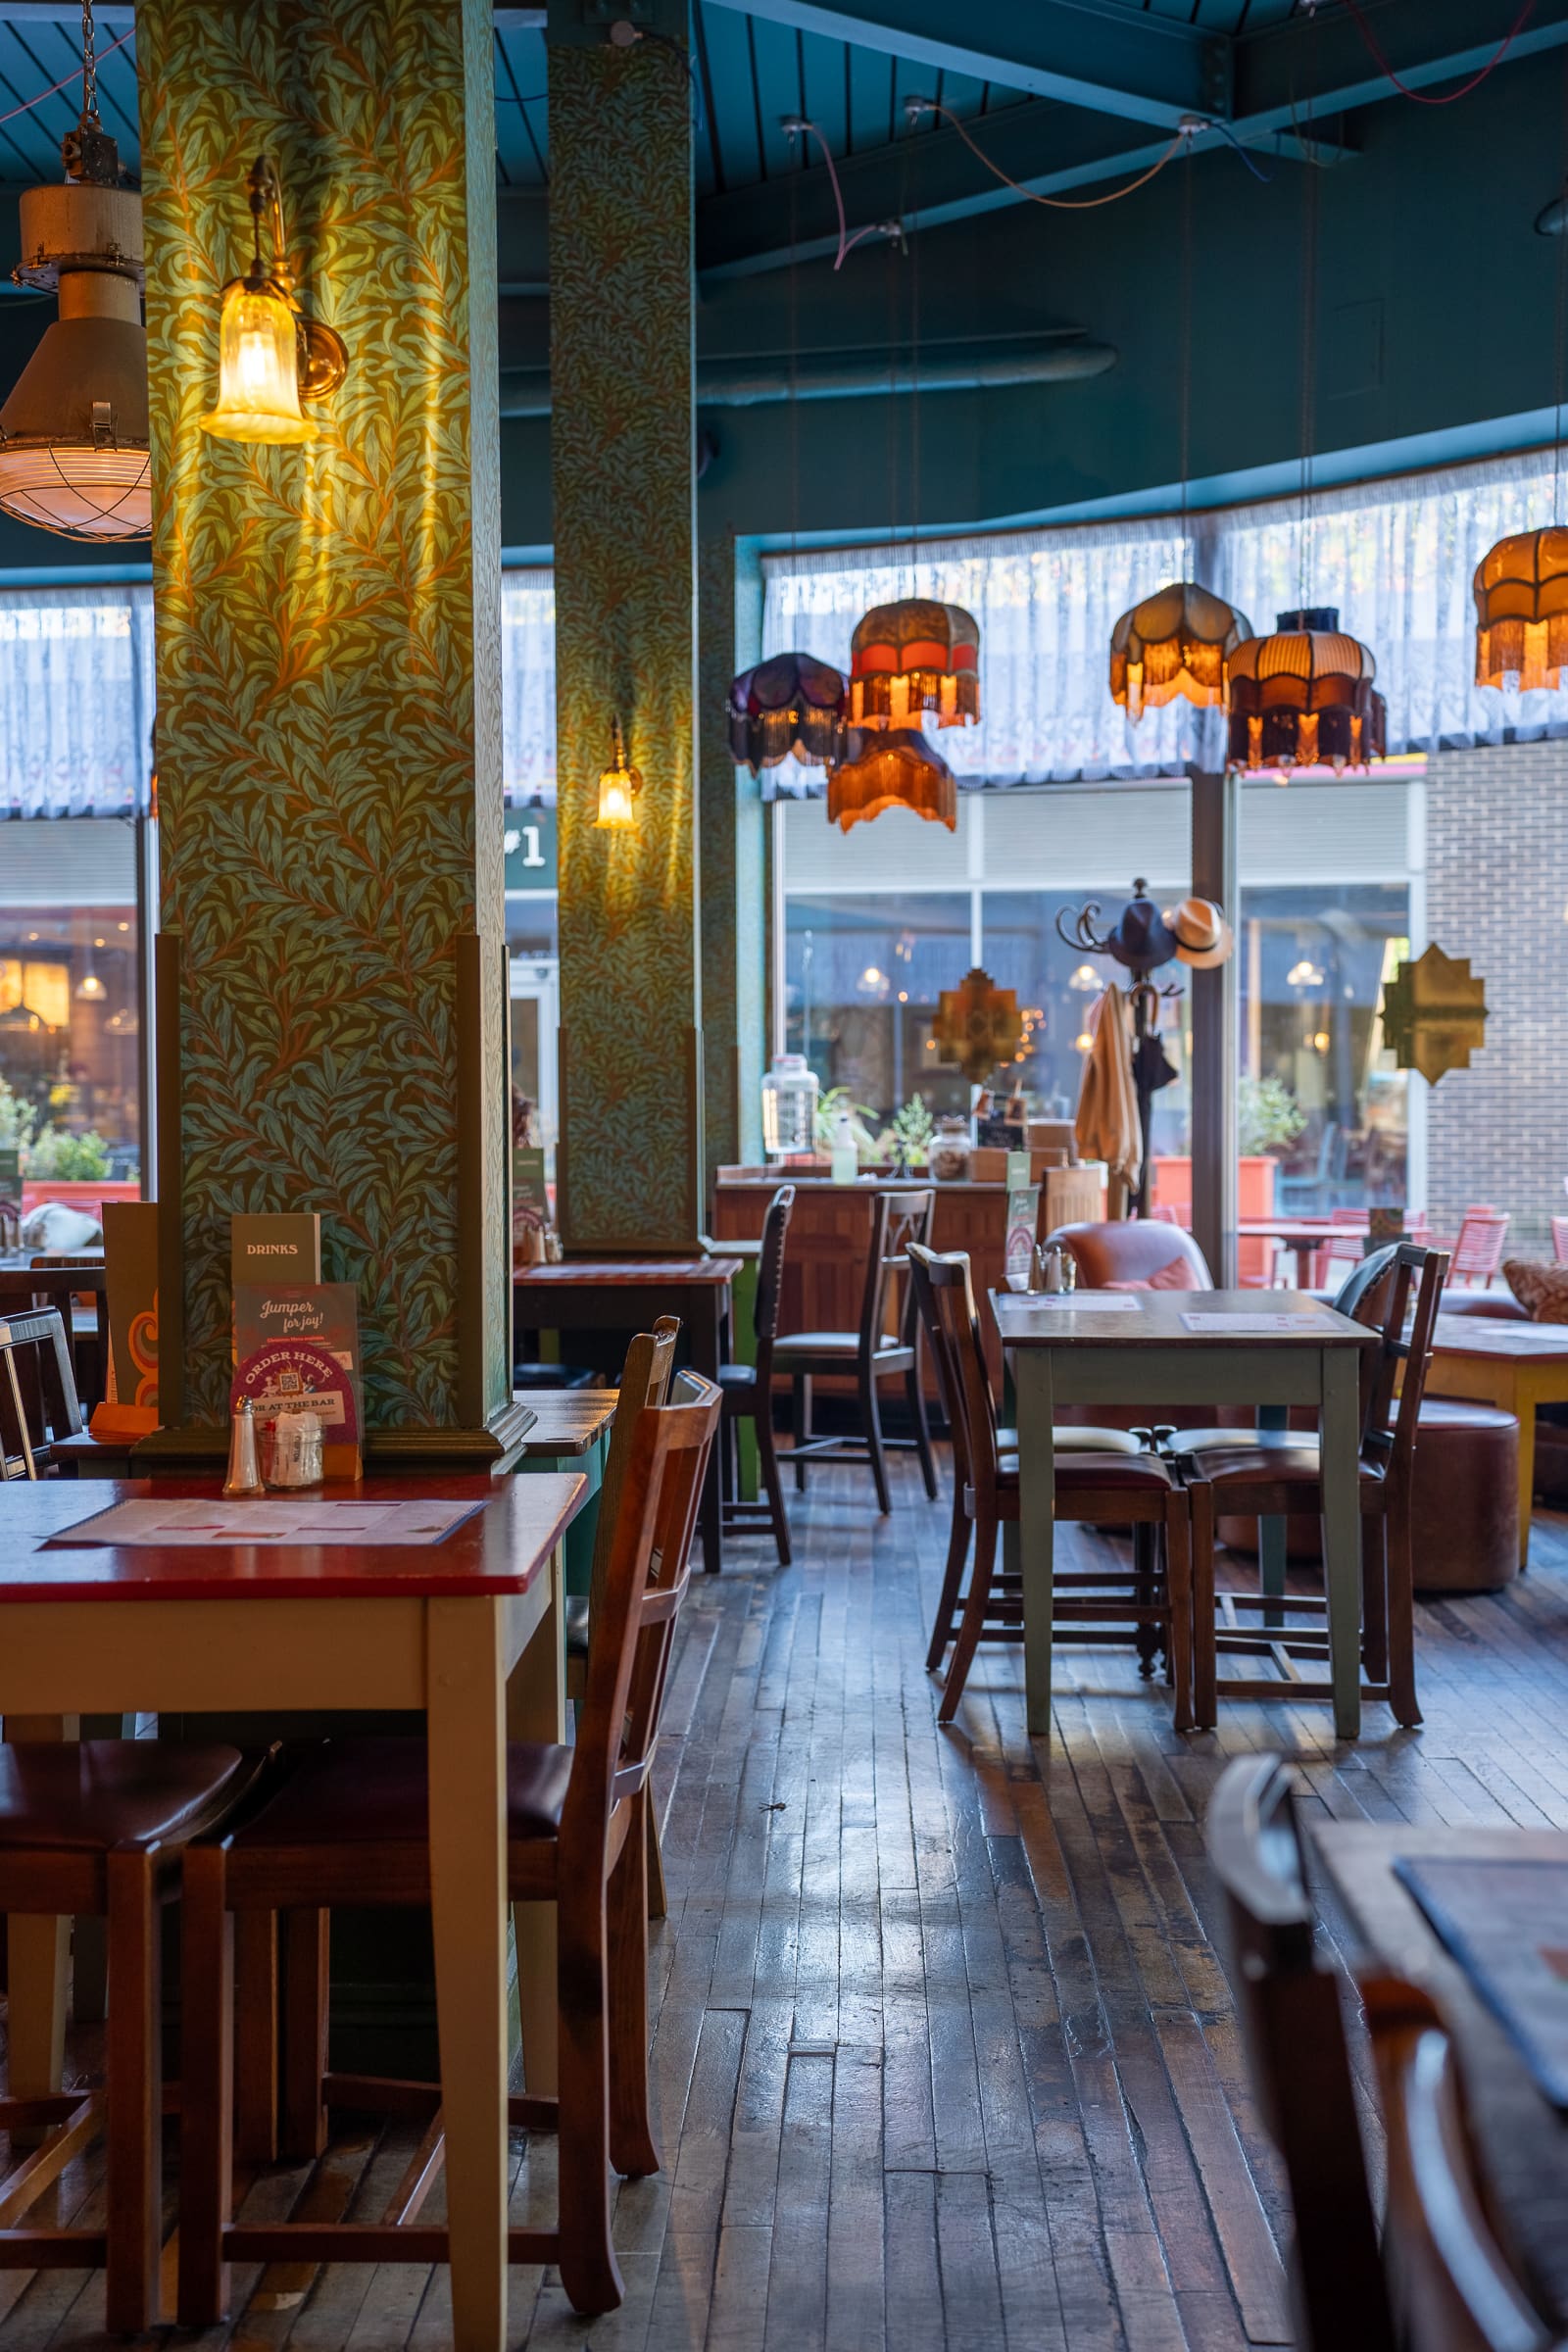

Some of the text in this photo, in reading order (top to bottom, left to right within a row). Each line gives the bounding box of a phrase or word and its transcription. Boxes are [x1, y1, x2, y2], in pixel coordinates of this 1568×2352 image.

[247, 1245, 298, 1254] DRINKS
[260, 1300, 315, 1319] Jumper
[283, 1312, 323, 1334] for joy!
[245, 1351, 333, 1384] ORDER HERE
